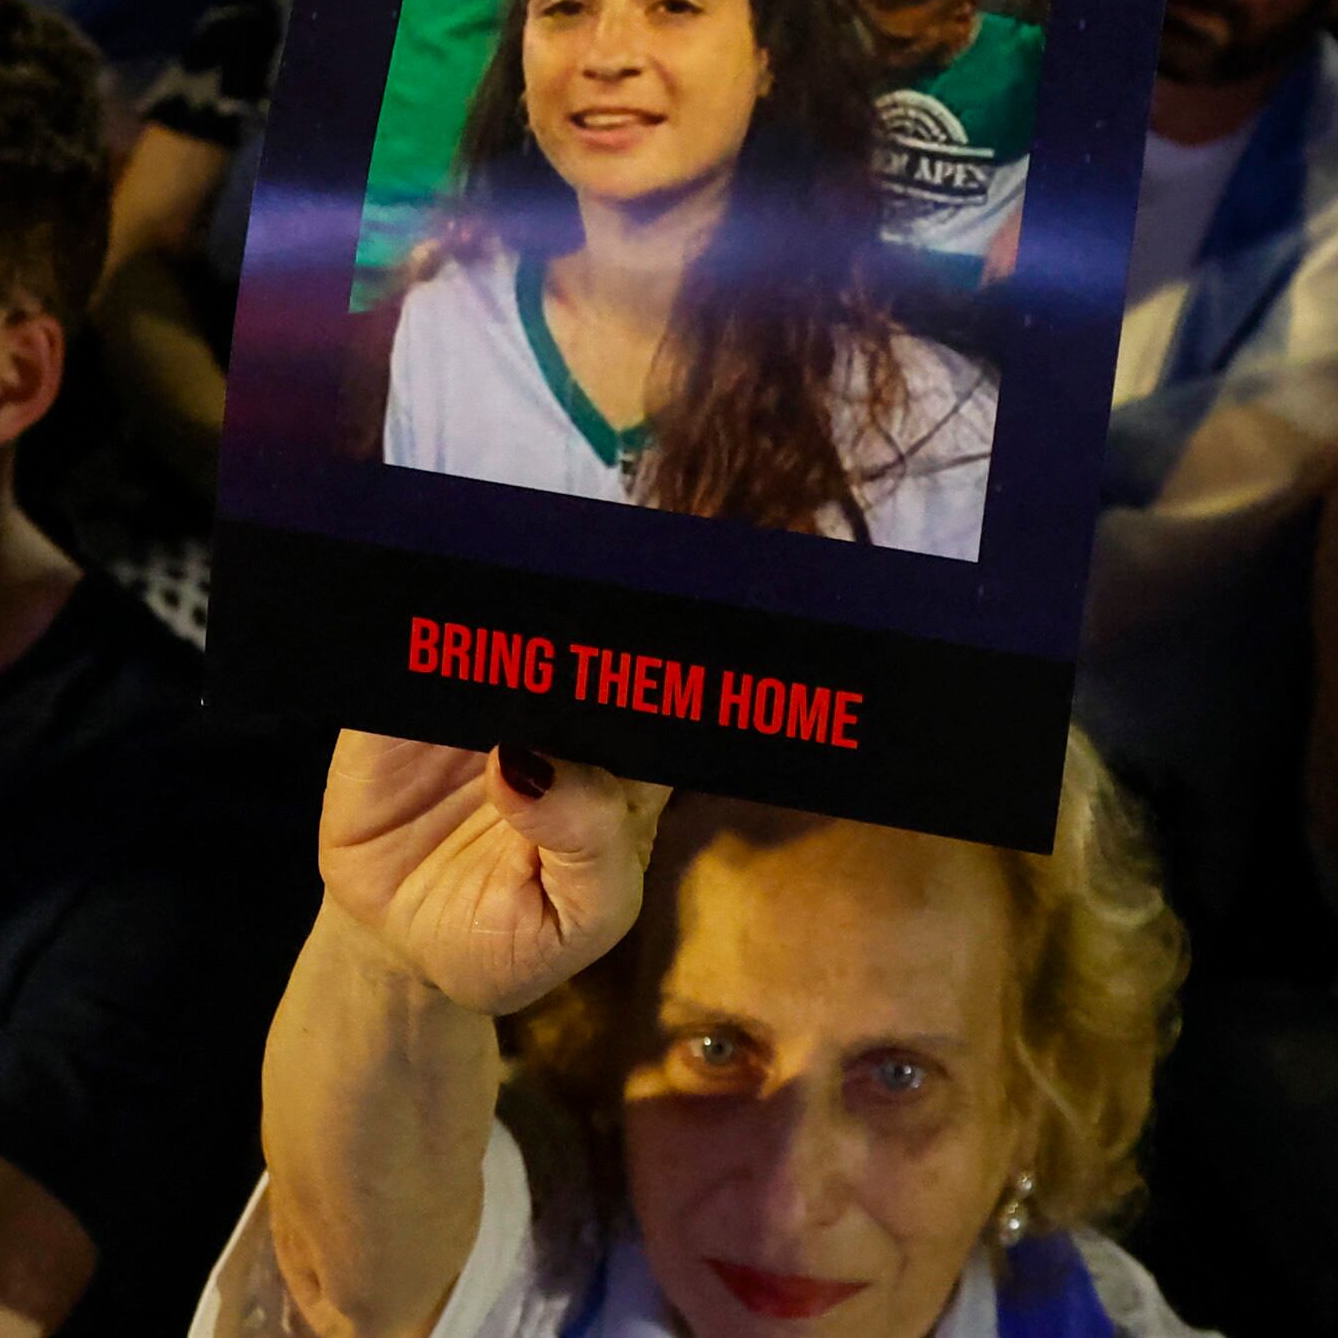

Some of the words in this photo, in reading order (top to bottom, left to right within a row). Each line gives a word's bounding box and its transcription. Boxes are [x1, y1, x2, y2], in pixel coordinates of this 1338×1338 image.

[408, 616, 555, 694] BRING
[569, 643, 706, 721] THEM
[718, 670, 864, 749] HOME
